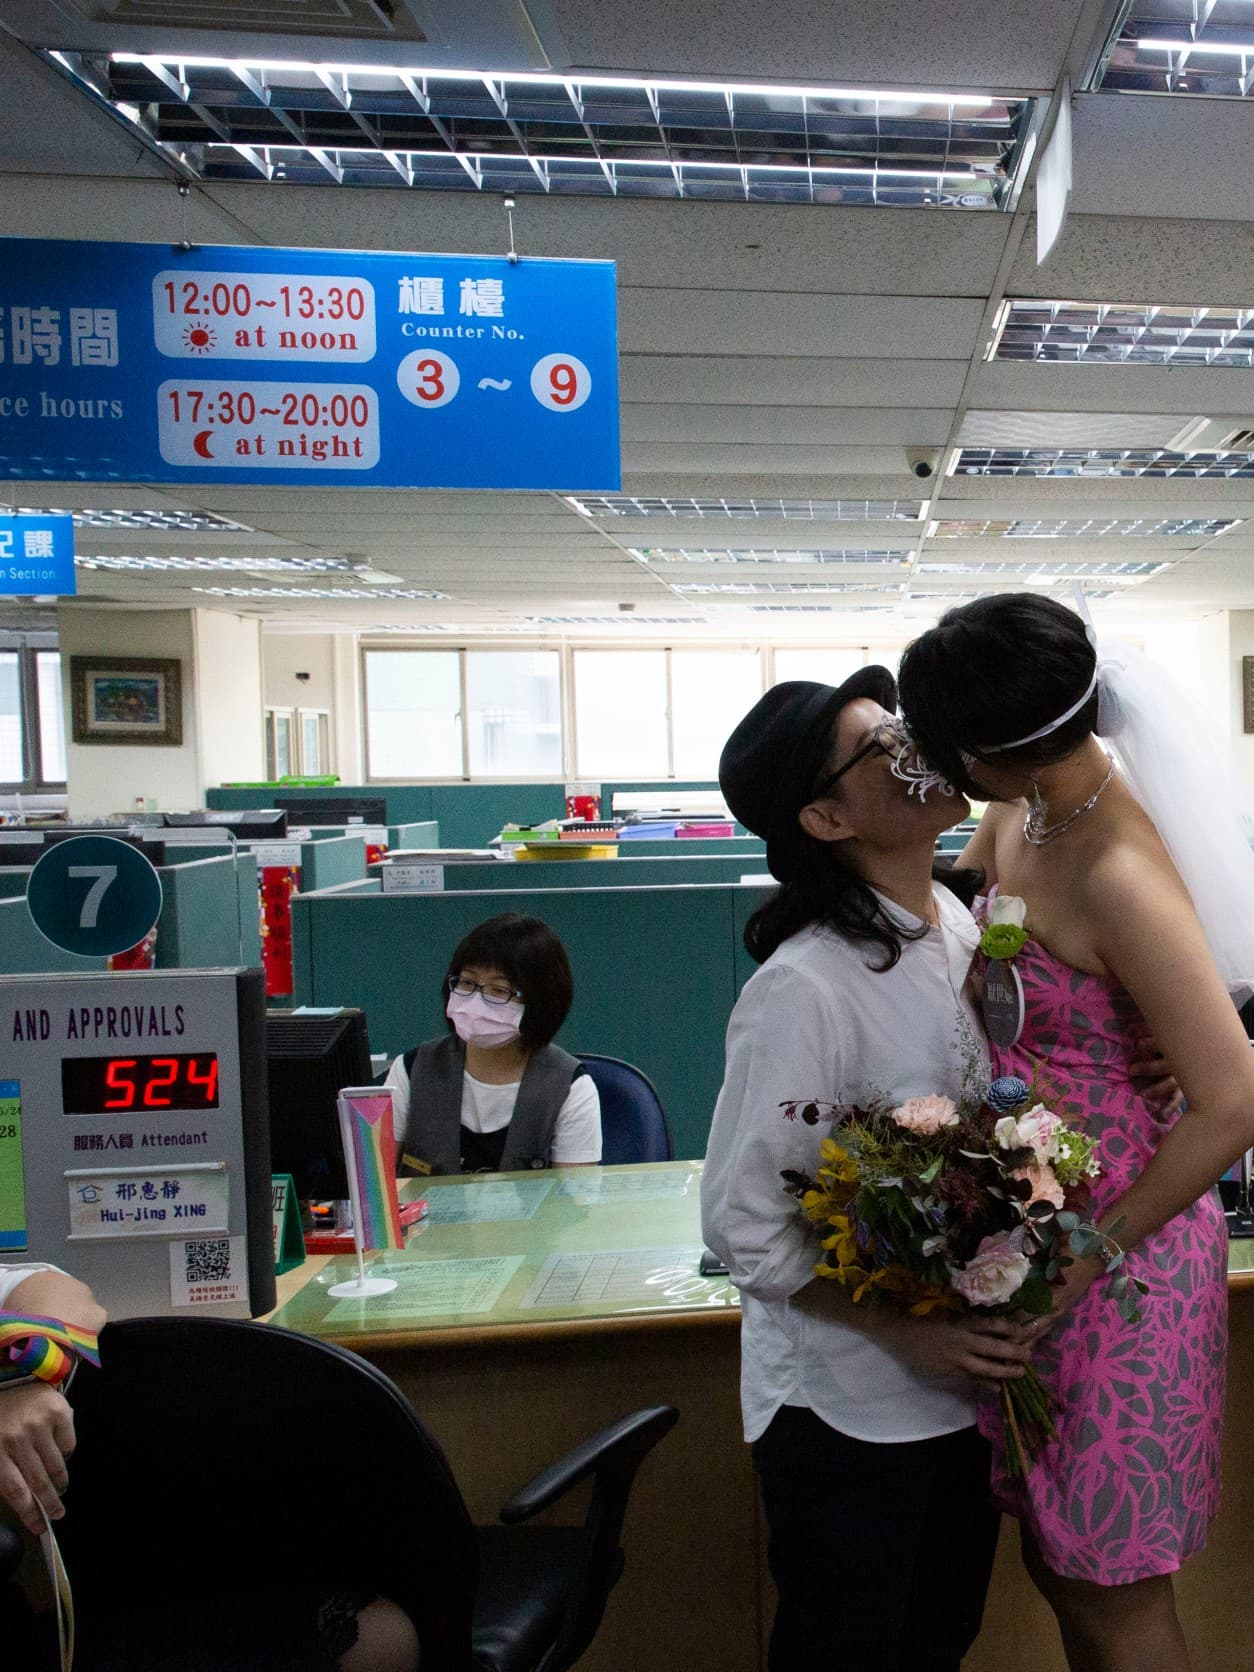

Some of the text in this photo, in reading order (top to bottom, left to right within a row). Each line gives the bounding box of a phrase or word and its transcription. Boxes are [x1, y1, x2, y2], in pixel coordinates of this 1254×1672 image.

[165, 282, 364, 320] 12:00~13:30
[0, 306, 118, 367] 時間
[235, 325, 358, 350] at noon
[401, 322, 525, 340] Counter No.
[416, 359, 445, 401] 3
[550, 363, 577, 405] 9
[40, 391, 124, 419] hours
[169, 391, 368, 427] 17:30~20:00
[235, 433, 364, 461] at night
[9, 567, 56, 580] Section
[68, 865, 118, 928] 7
[12, 1004, 185, 1042] AND APPROVALS
[104, 1058, 219, 1108] 524
[74, 1133, 135, 1151] 服務人員
[141, 1131, 208, 1147] Attendant
[173, 1204, 206, 1218] XING
